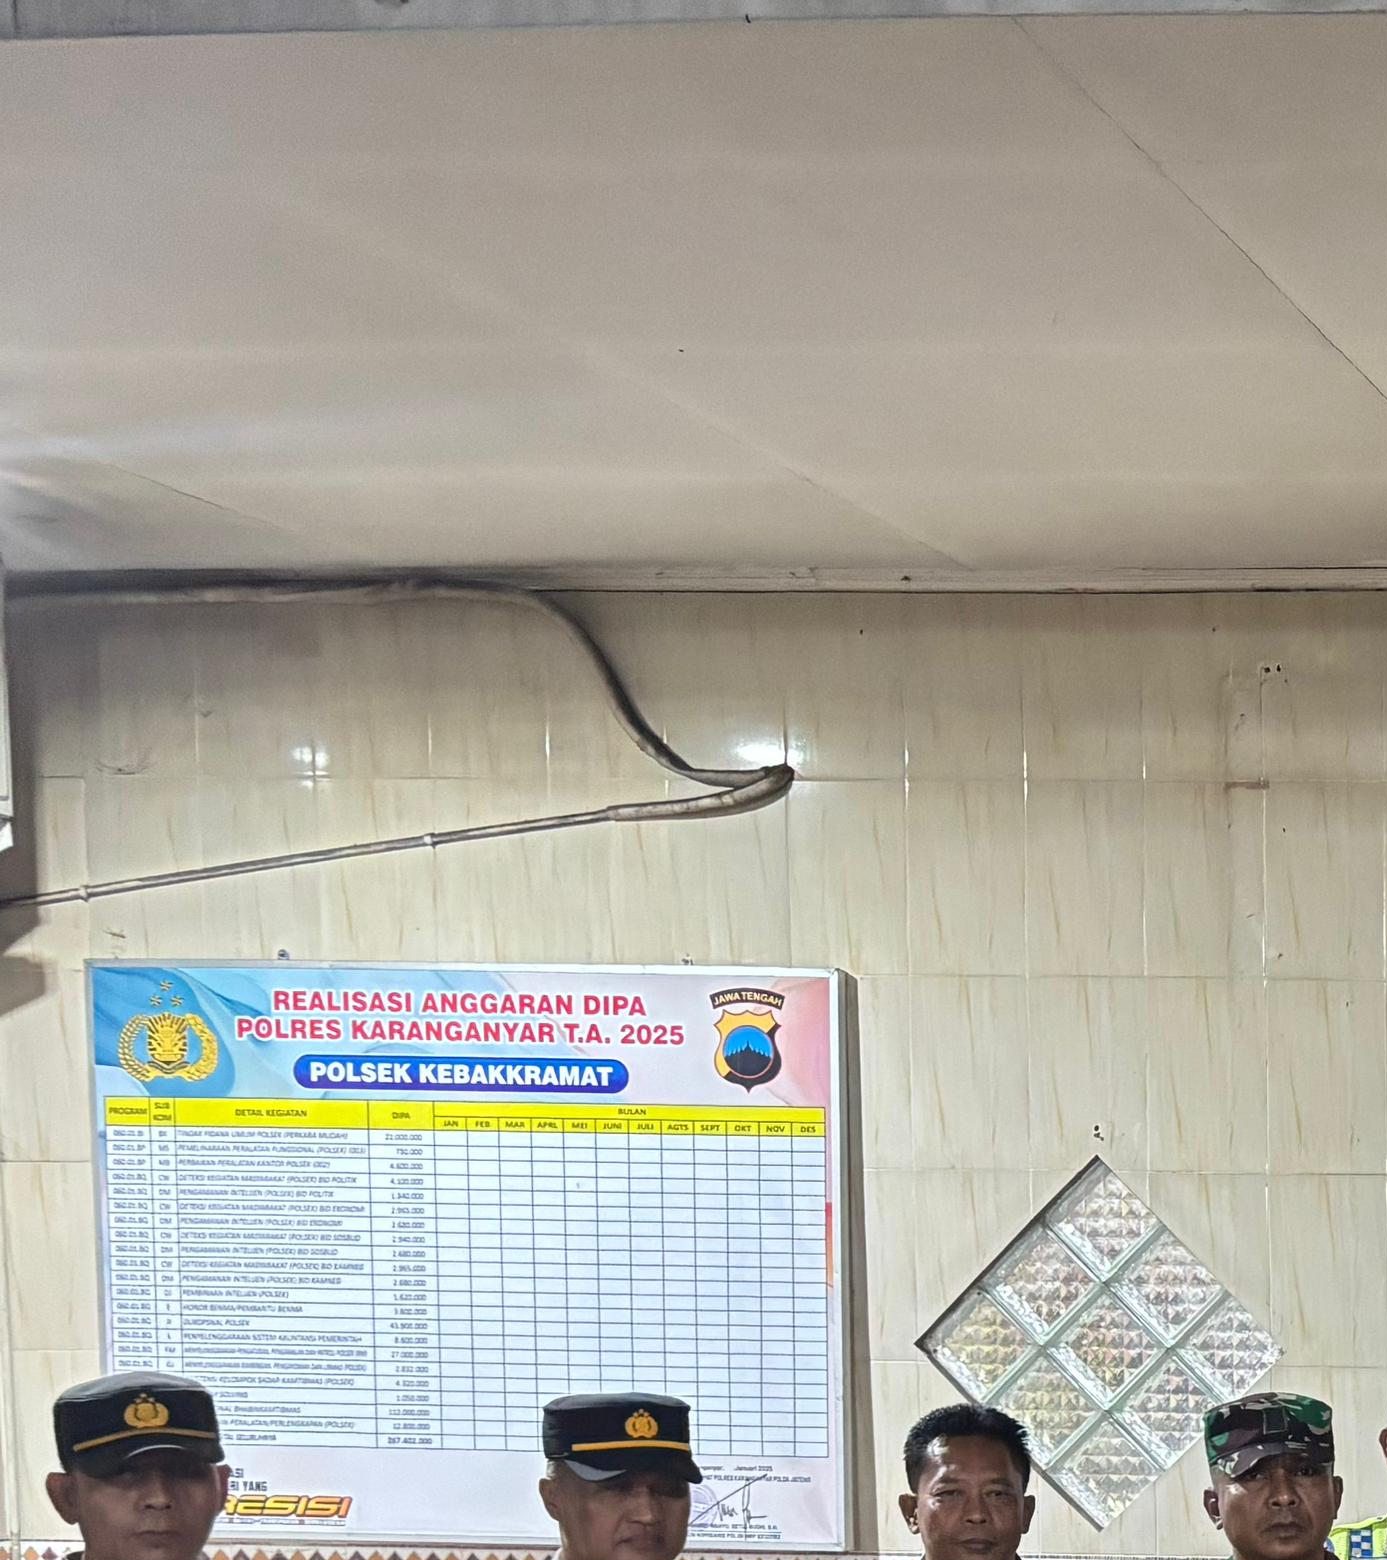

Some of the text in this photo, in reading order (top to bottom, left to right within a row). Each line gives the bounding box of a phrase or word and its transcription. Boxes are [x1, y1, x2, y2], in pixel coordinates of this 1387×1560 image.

[273, 990, 646, 1016] REALISASI ANGGARAN DIPA
[713, 991, 782, 1007] JAWA TENGAH
[237, 1018, 684, 1045] POLRES KARANGANYAR T.A. 2025
[309, 1061, 613, 1086] POLSEK KEBAKKRAMAT
[108, 1108, 148, 1116] PROGRAM
[392, 1111, 410, 1120] DIPA
[617, 1108, 647, 1116] BULAN
[475, 1120, 491, 1128] FEB
[602, 1122, 622, 1130] JUNI
[636, 1123, 654, 1131] JULI
[734, 1125, 751, 1133] OKT
[766, 1125, 785, 1133] NOV
[799, 1126, 816, 1134] DES
[243, 1481, 268, 1492] YANG
[225, 1494, 353, 1519] RESISI
